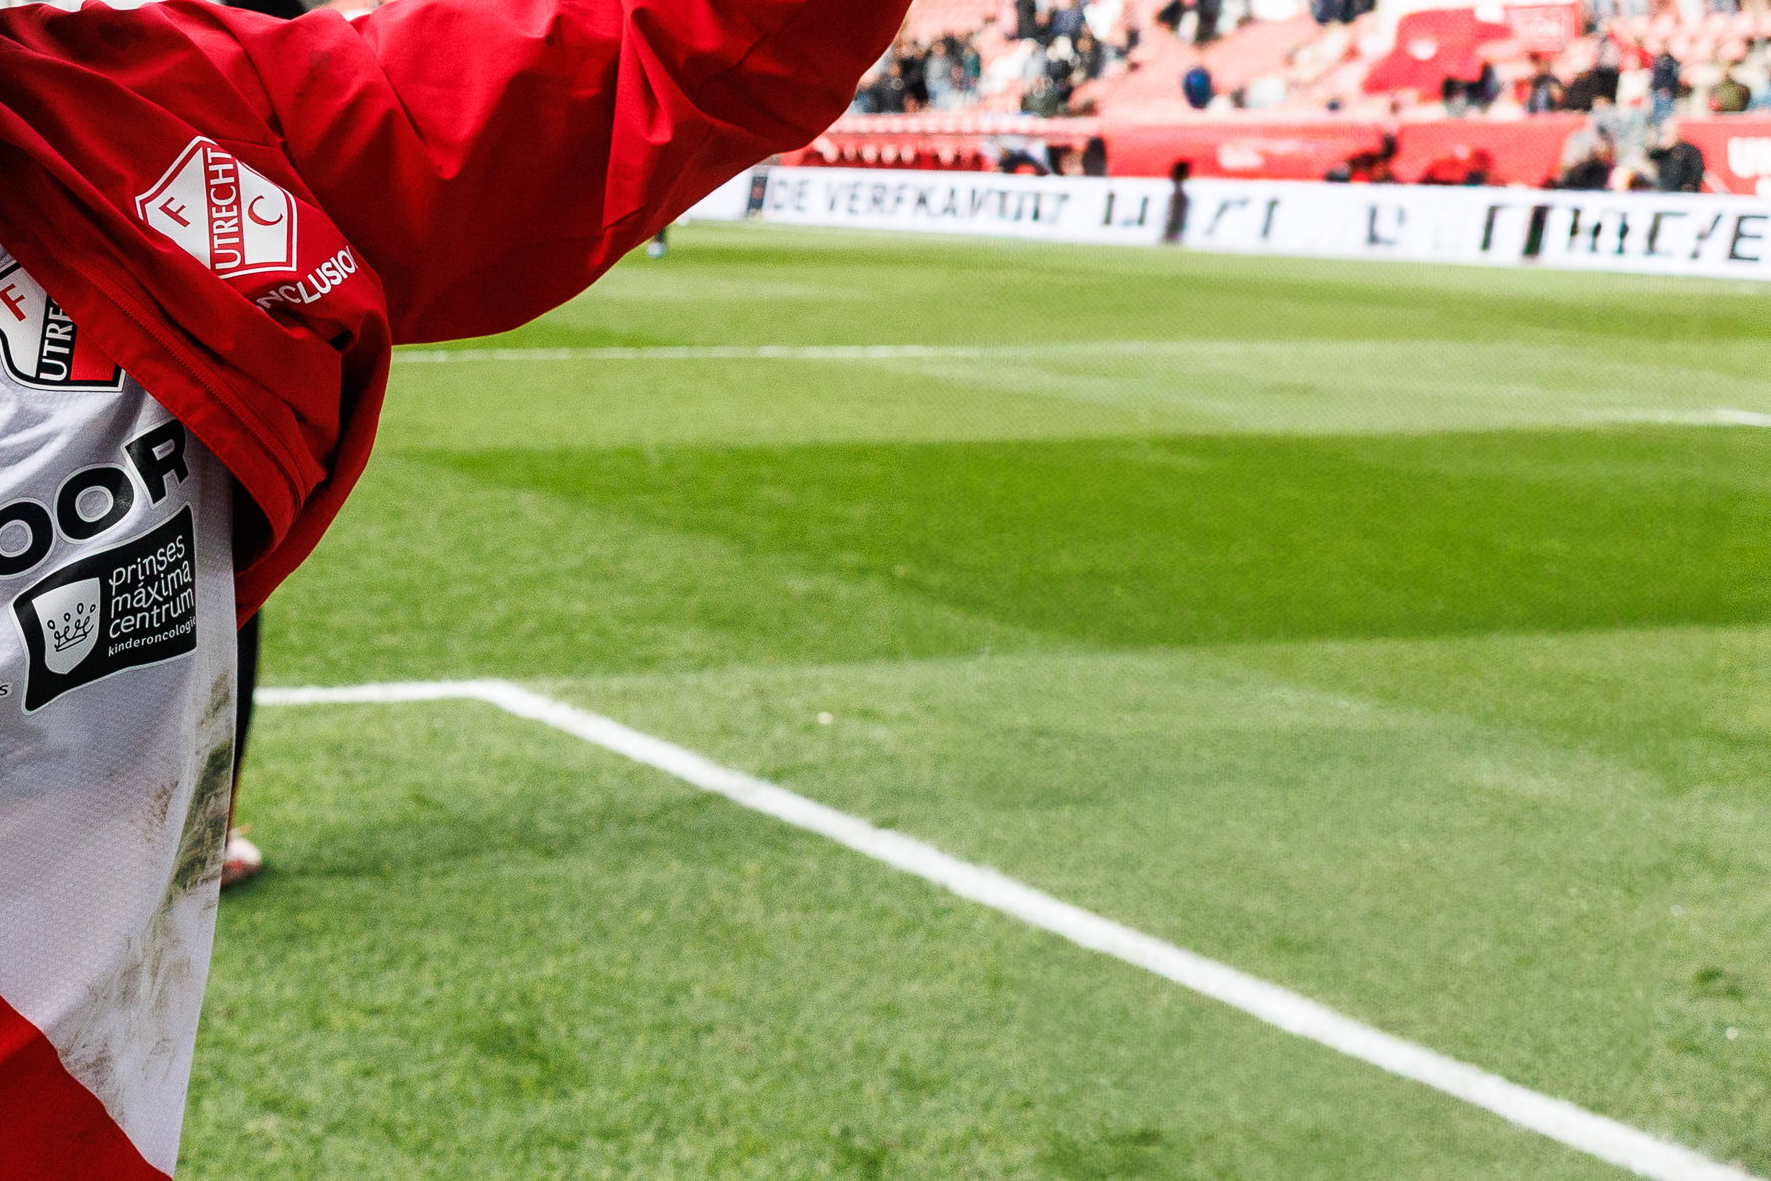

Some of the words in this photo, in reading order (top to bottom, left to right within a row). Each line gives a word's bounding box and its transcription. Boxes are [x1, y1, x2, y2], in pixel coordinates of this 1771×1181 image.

[158, 196, 191, 228] F
[206, 147, 242, 270] UTRECHT
[247, 194, 284, 227] C
[257, 245, 359, 316] NCLUSIO
[38, 299, 74, 382] UTRE
[107, 534, 186, 597] prinses
[110, 560, 193, 619] máxima
[108, 587, 195, 639] centrum
